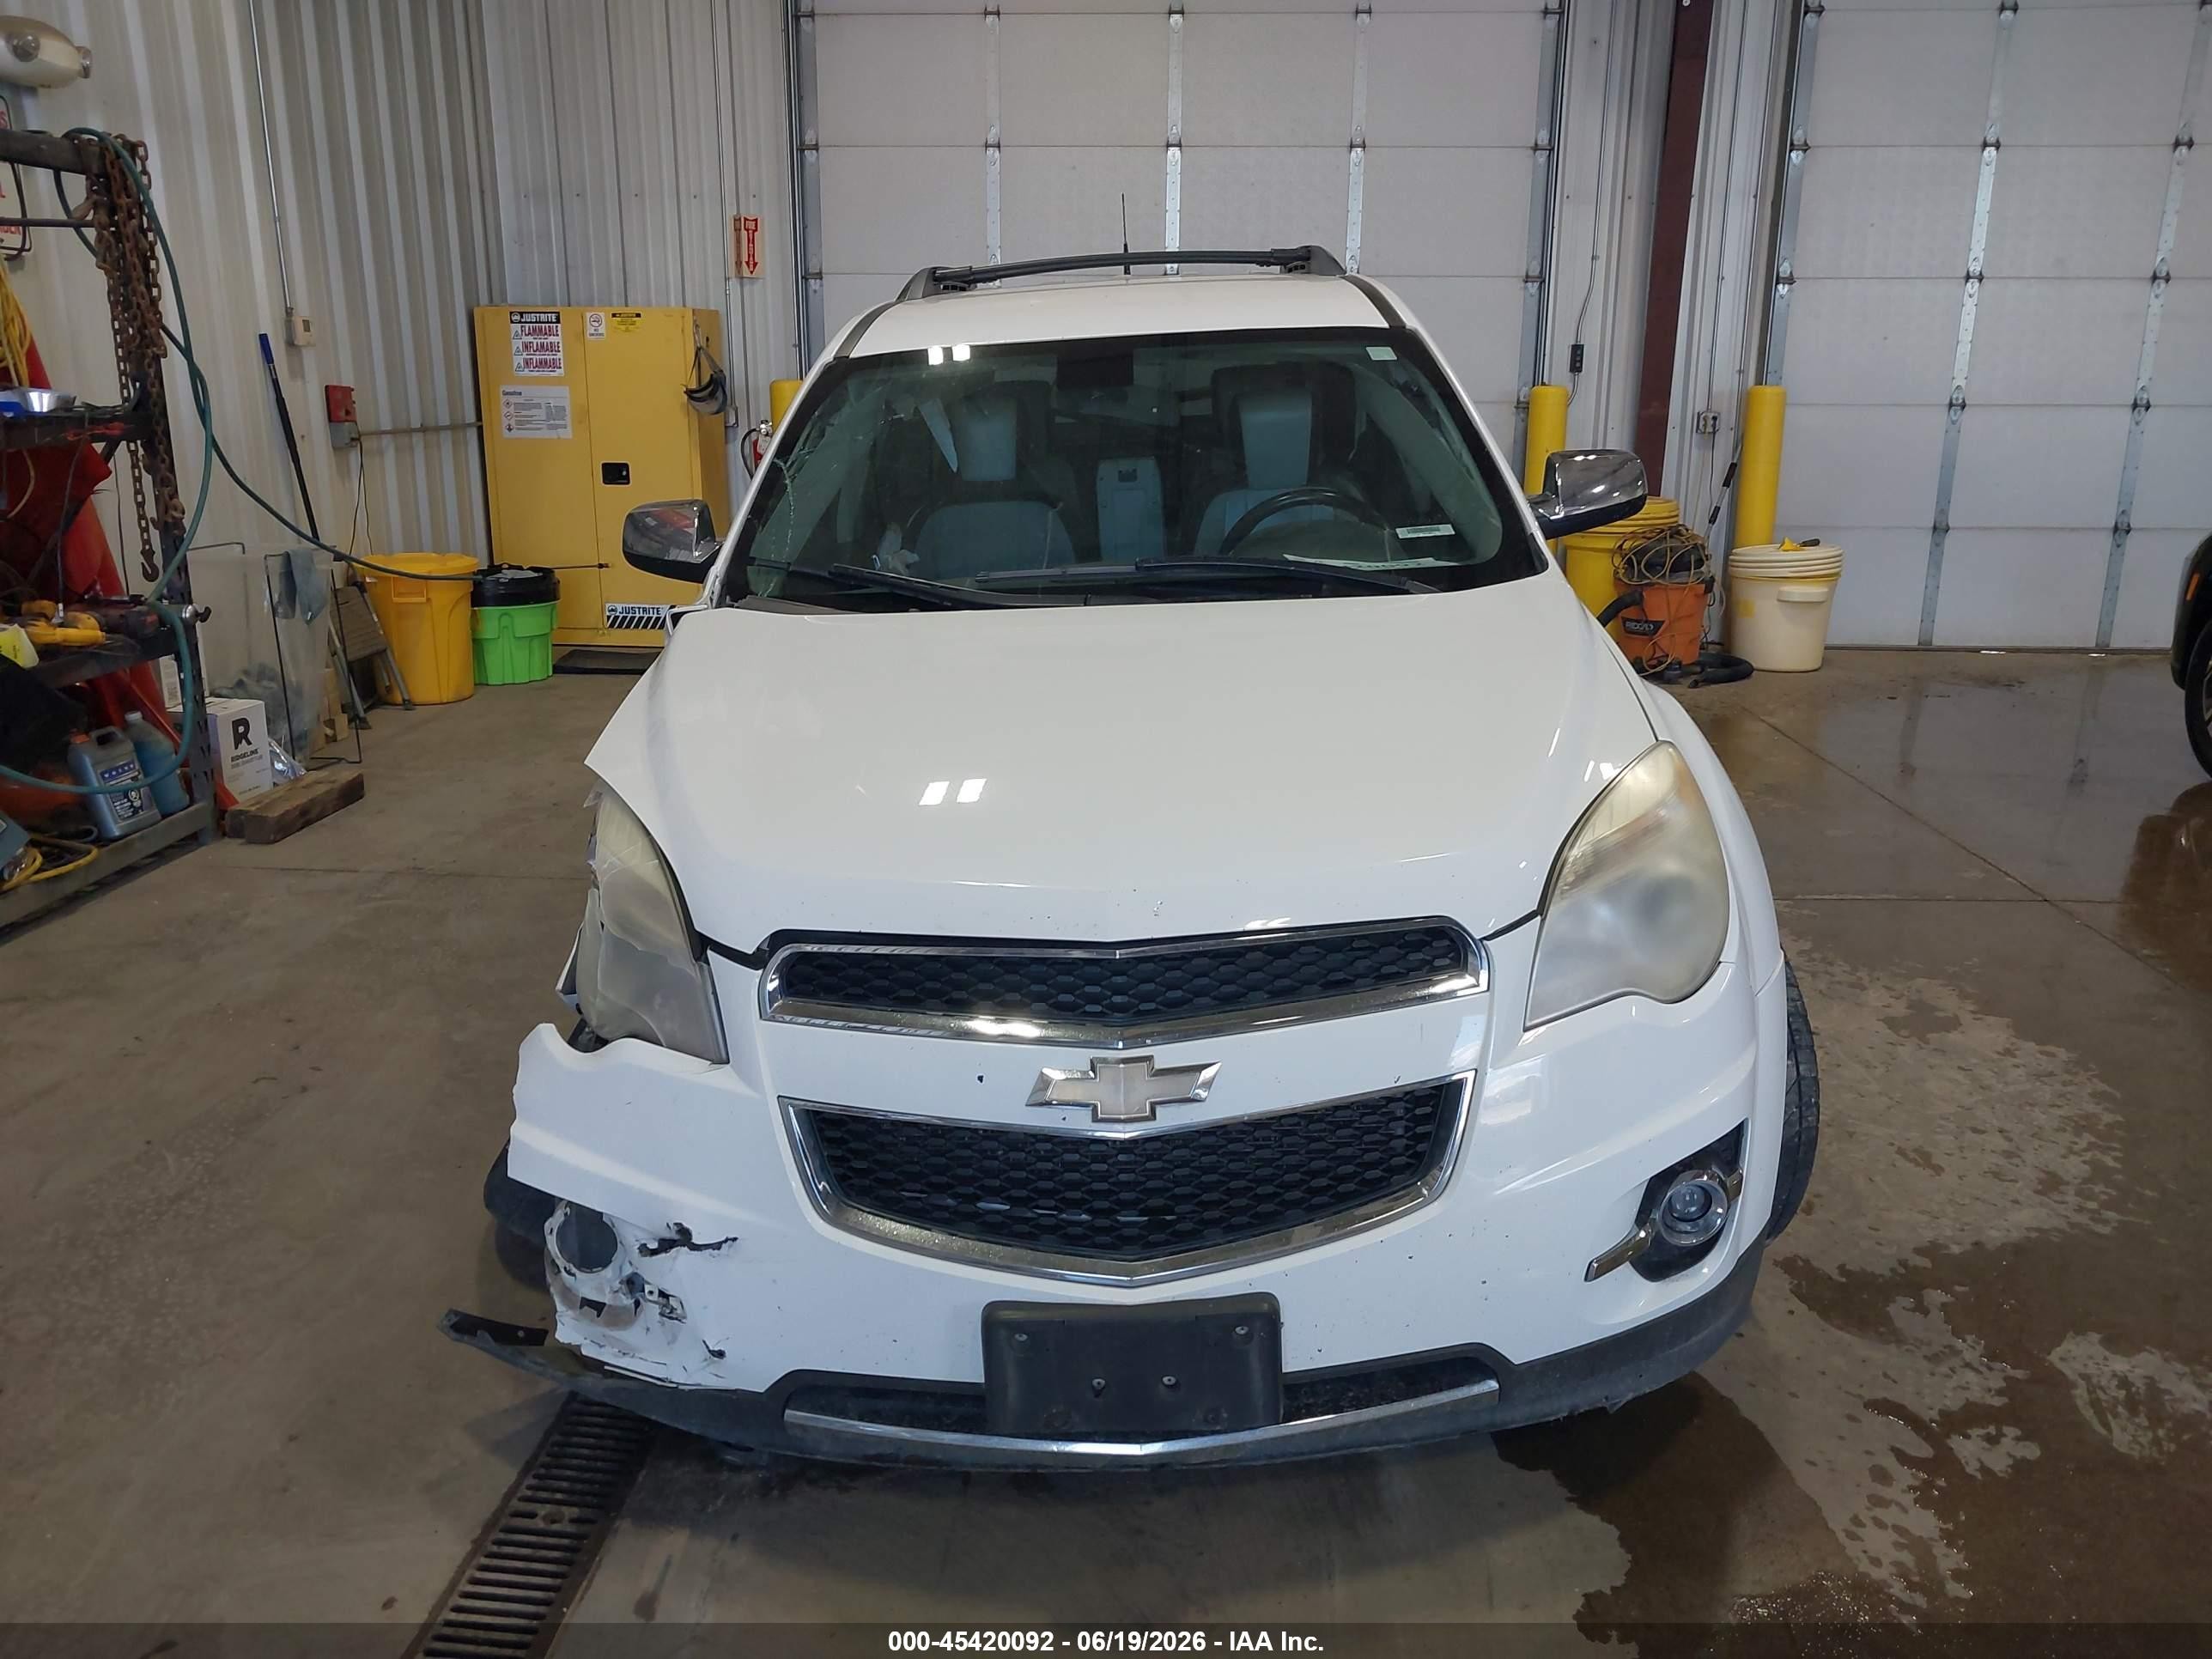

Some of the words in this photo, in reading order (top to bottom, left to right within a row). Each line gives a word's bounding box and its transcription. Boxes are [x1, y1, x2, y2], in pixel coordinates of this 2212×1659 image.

[520, 313, 557, 322] JUSTRITE
[520, 325, 559, 337] FLAMMABLE
[522, 341, 561, 353] INFLAMABLE
[523, 357, 562, 369] INFLAMMABLE
[619, 606, 660, 616] JUSTRITE
[232, 718, 252, 750] R
